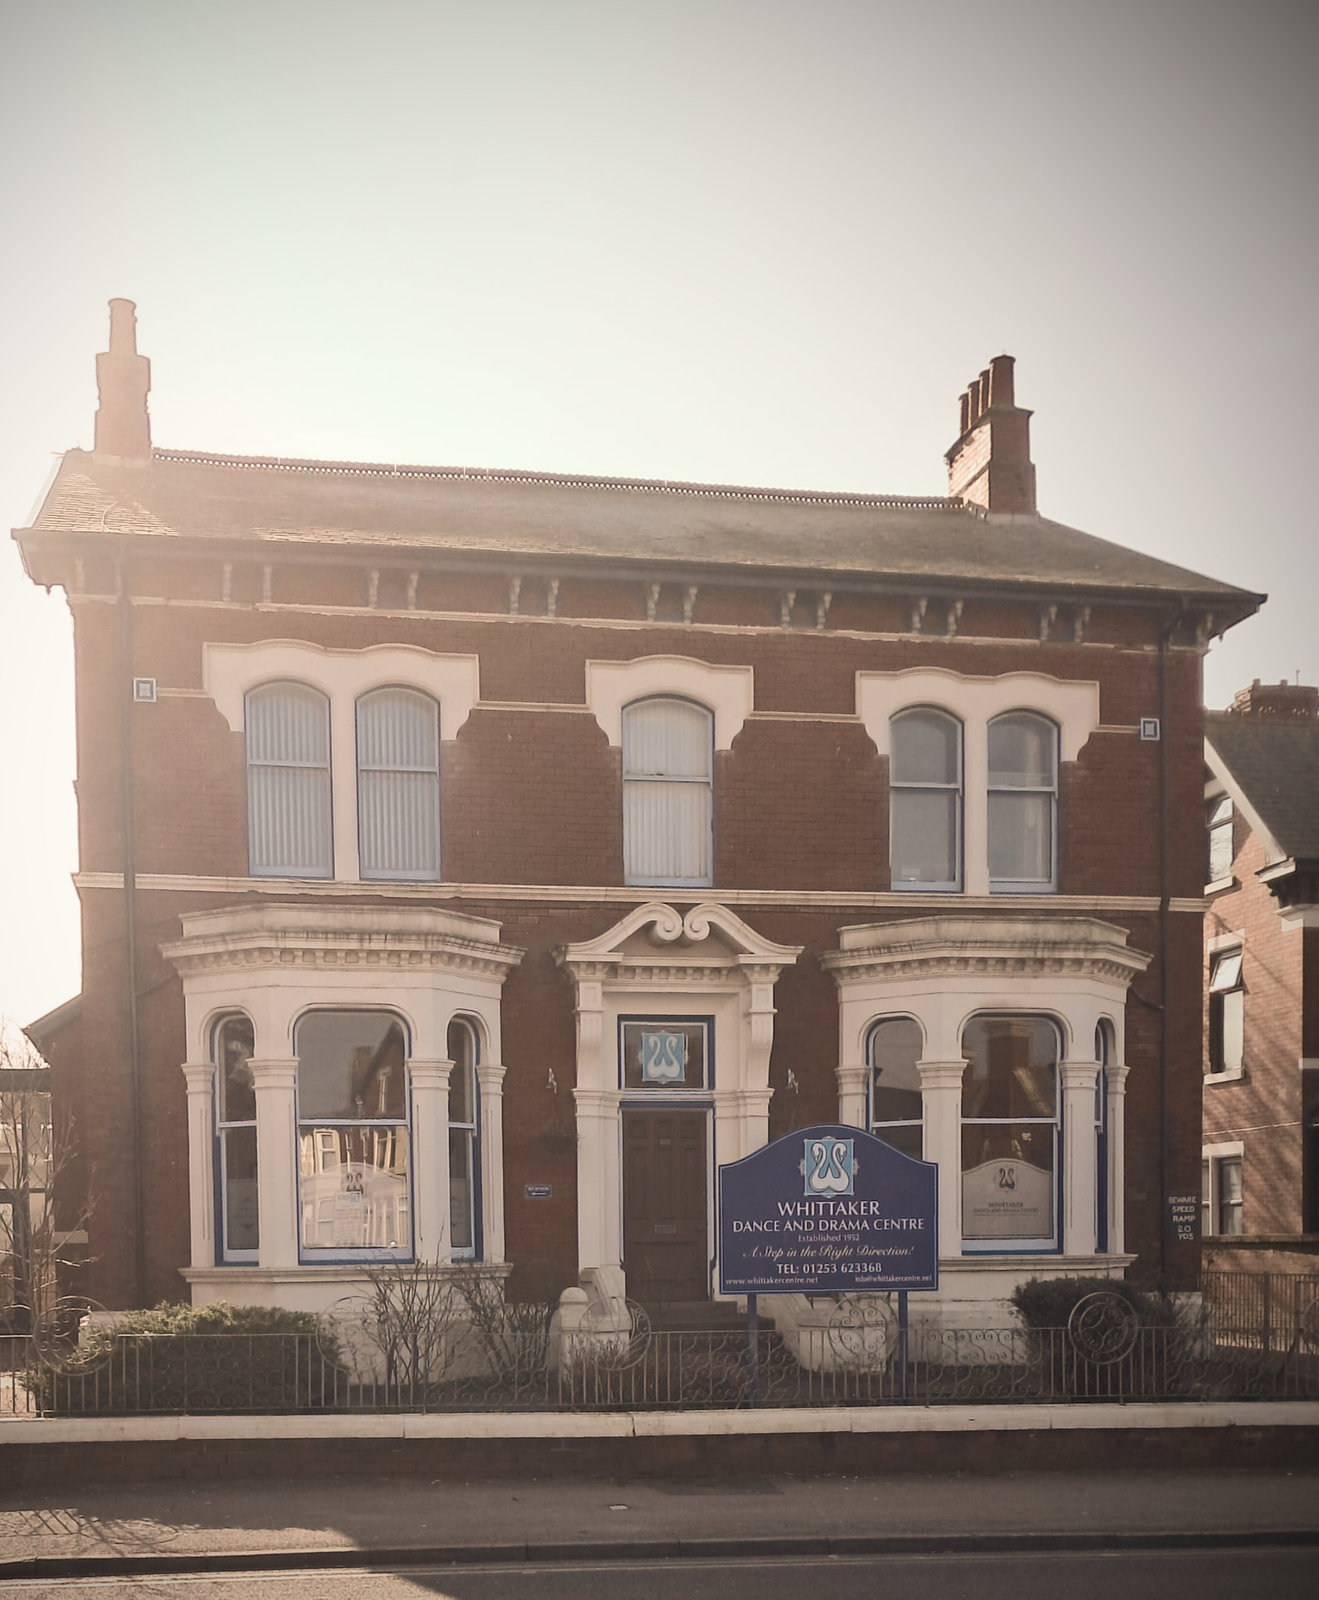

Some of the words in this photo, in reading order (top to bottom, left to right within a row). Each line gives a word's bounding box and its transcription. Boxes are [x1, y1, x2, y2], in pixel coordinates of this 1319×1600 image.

[777, 1200, 881, 1216] WHITTAKER
[1172, 1205, 1195, 1213] SPEED
[732, 1220, 780, 1233] DANCE
[783, 1219, 815, 1231] AND
[818, 1219, 870, 1231] DRAMA
[873, 1218, 925, 1230] CENTRE
[1177, 1225, 1192, 1233] 20
[797, 1234, 841, 1242] Established
[758, 1245, 784, 1262] Step
[786, 1247, 798, 1257] in
[799, 1245, 817, 1257] the
[819, 1245, 853, 1260] Right
[856, 1243, 915, 1256] Direction!
[776, 1263, 800, 1274] TEL:
[802, 1263, 838, 1273] 01253
[841, 1262, 882, 1273] 623368
